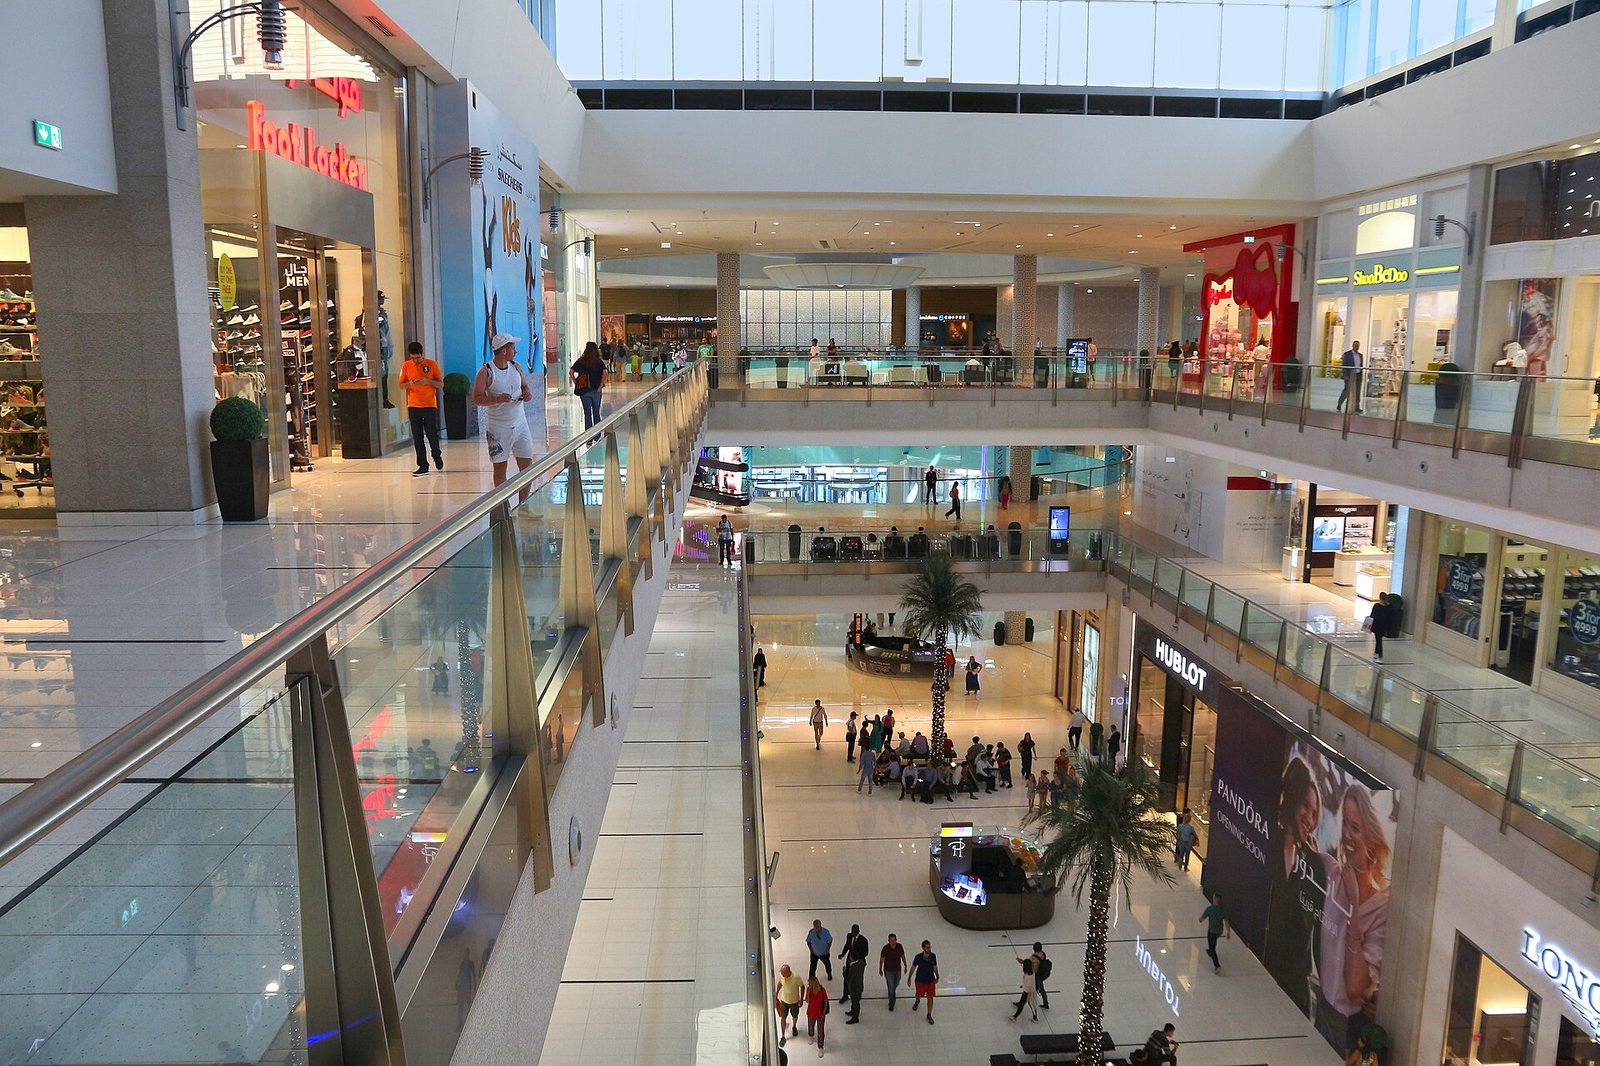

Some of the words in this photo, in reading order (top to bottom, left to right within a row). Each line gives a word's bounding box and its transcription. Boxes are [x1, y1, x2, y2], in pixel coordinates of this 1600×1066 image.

[246, 100, 305, 167] Foot
[304, 127, 369, 192] Locker
[497, 167, 523, 195] SKECHERS
[501, 194, 521, 257] Kids
[284, 263, 308, 277] جال
[1353, 264, 1409, 286] ShooBeDoo
[1453, 563, 1461, 579] 3
[1460, 571, 1471, 582] for
[1577, 602, 1587, 620] 3
[1587, 611, 1600, 625] for
[1155, 638, 1207, 692] HUBLOT
[1217, 778, 1269, 840] PANDORA
[1217, 810, 1245, 844] OPENING
[1245, 837, 1266, 865] SOON
